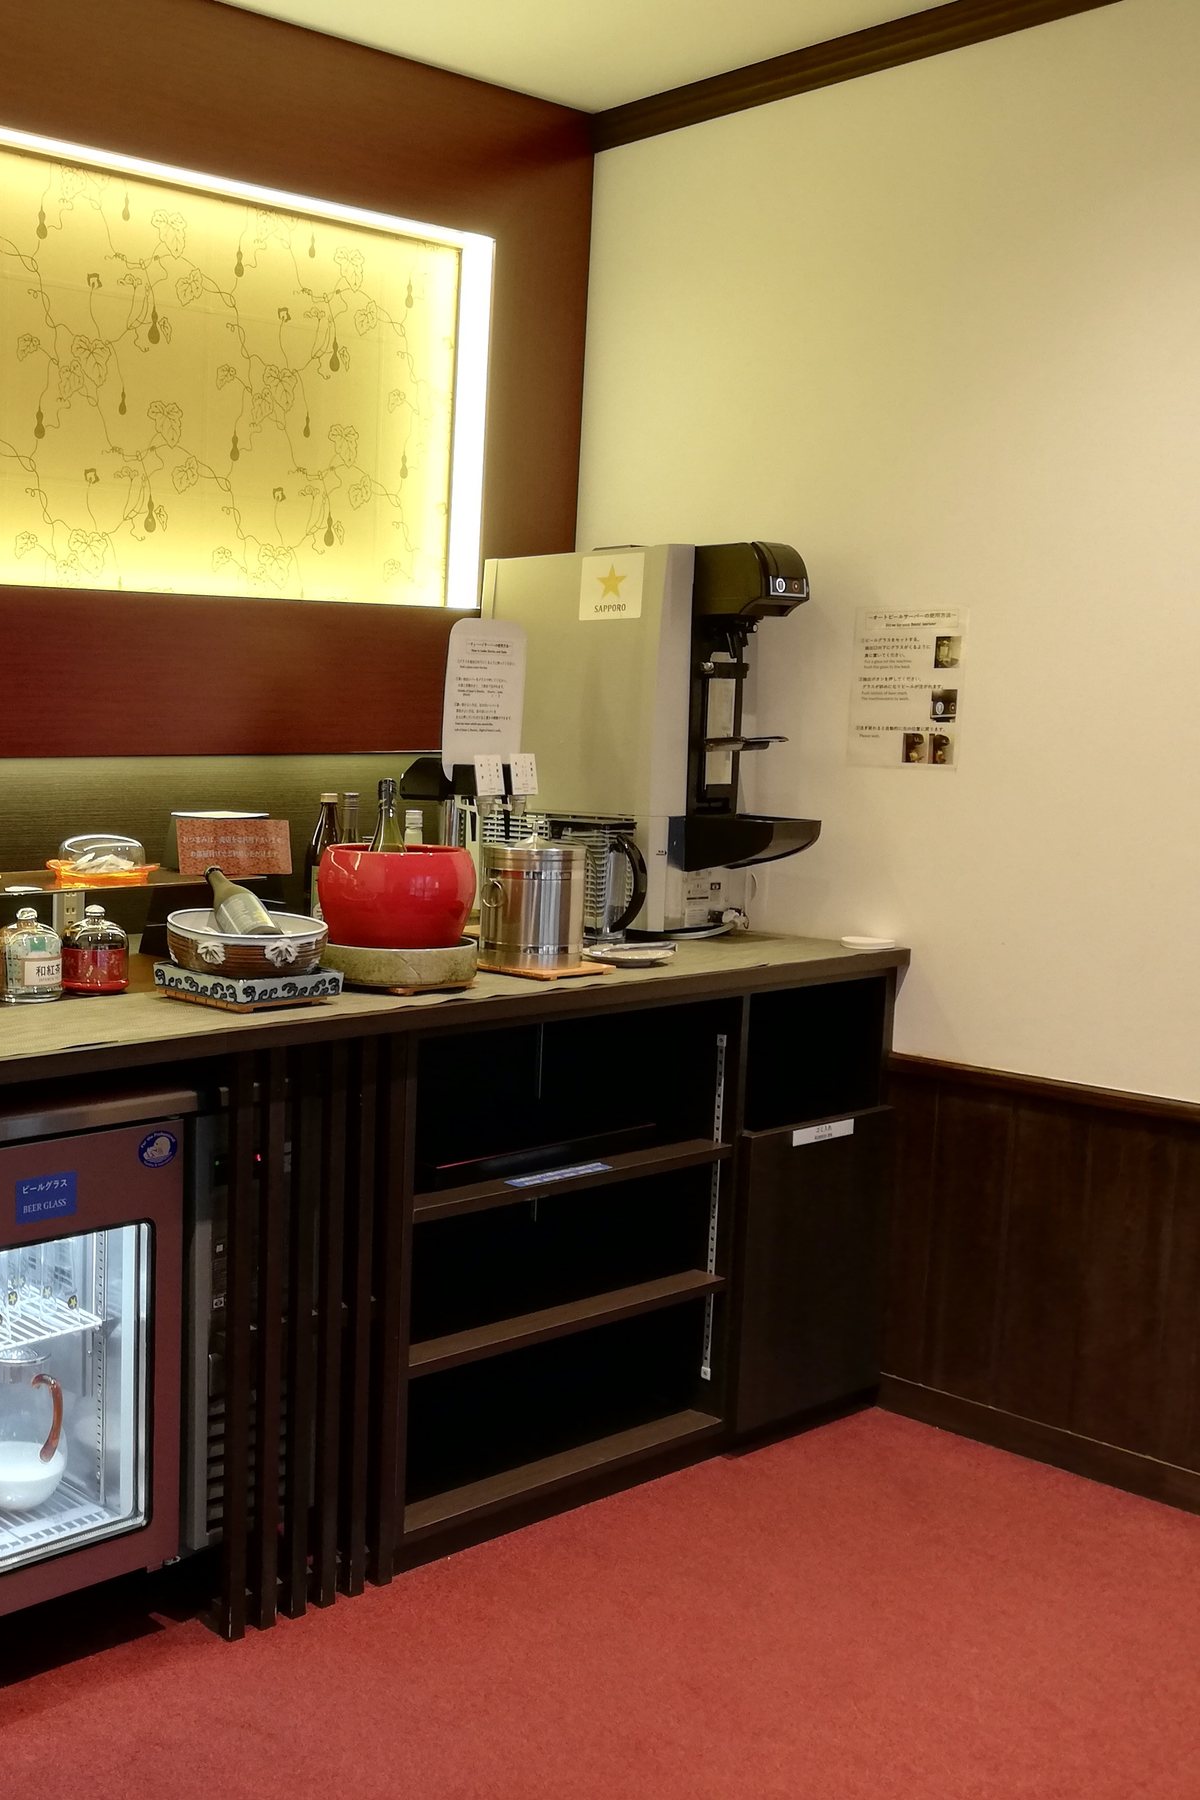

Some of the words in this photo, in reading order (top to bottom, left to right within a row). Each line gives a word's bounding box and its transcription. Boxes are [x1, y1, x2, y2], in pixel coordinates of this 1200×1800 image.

[594, 603, 627, 613] SAPPORO
[22, 1178, 68, 1195] ビールグラス
[23, 1203, 42, 1214] BEER
[43, 1198, 67, 1210] GLASS
